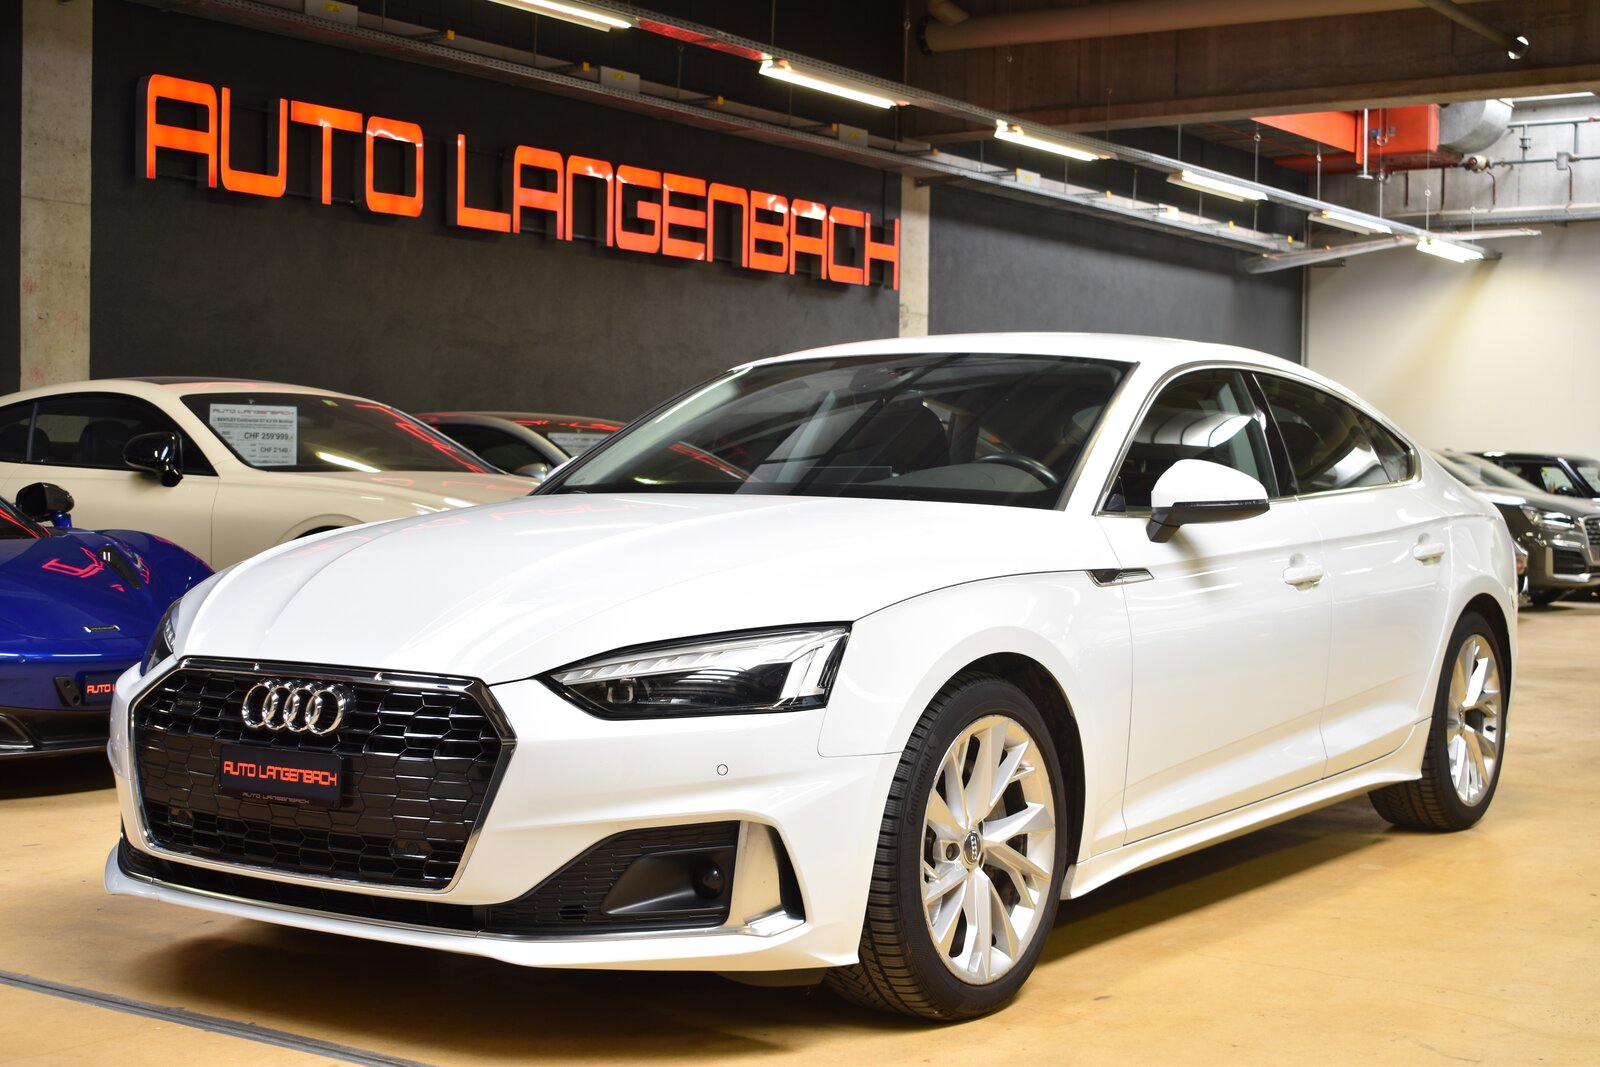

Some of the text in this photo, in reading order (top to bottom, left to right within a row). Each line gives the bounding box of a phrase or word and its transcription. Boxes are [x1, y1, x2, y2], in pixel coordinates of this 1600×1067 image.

[146, 74, 901, 290] AUTO LANGENBACH
[244, 432, 259, 440] CHF
[86, 683, 111, 694] AUTO
[223, 760, 337, 786] AUTO LANGENBACH
[242, 791, 261, 799] AUTO
